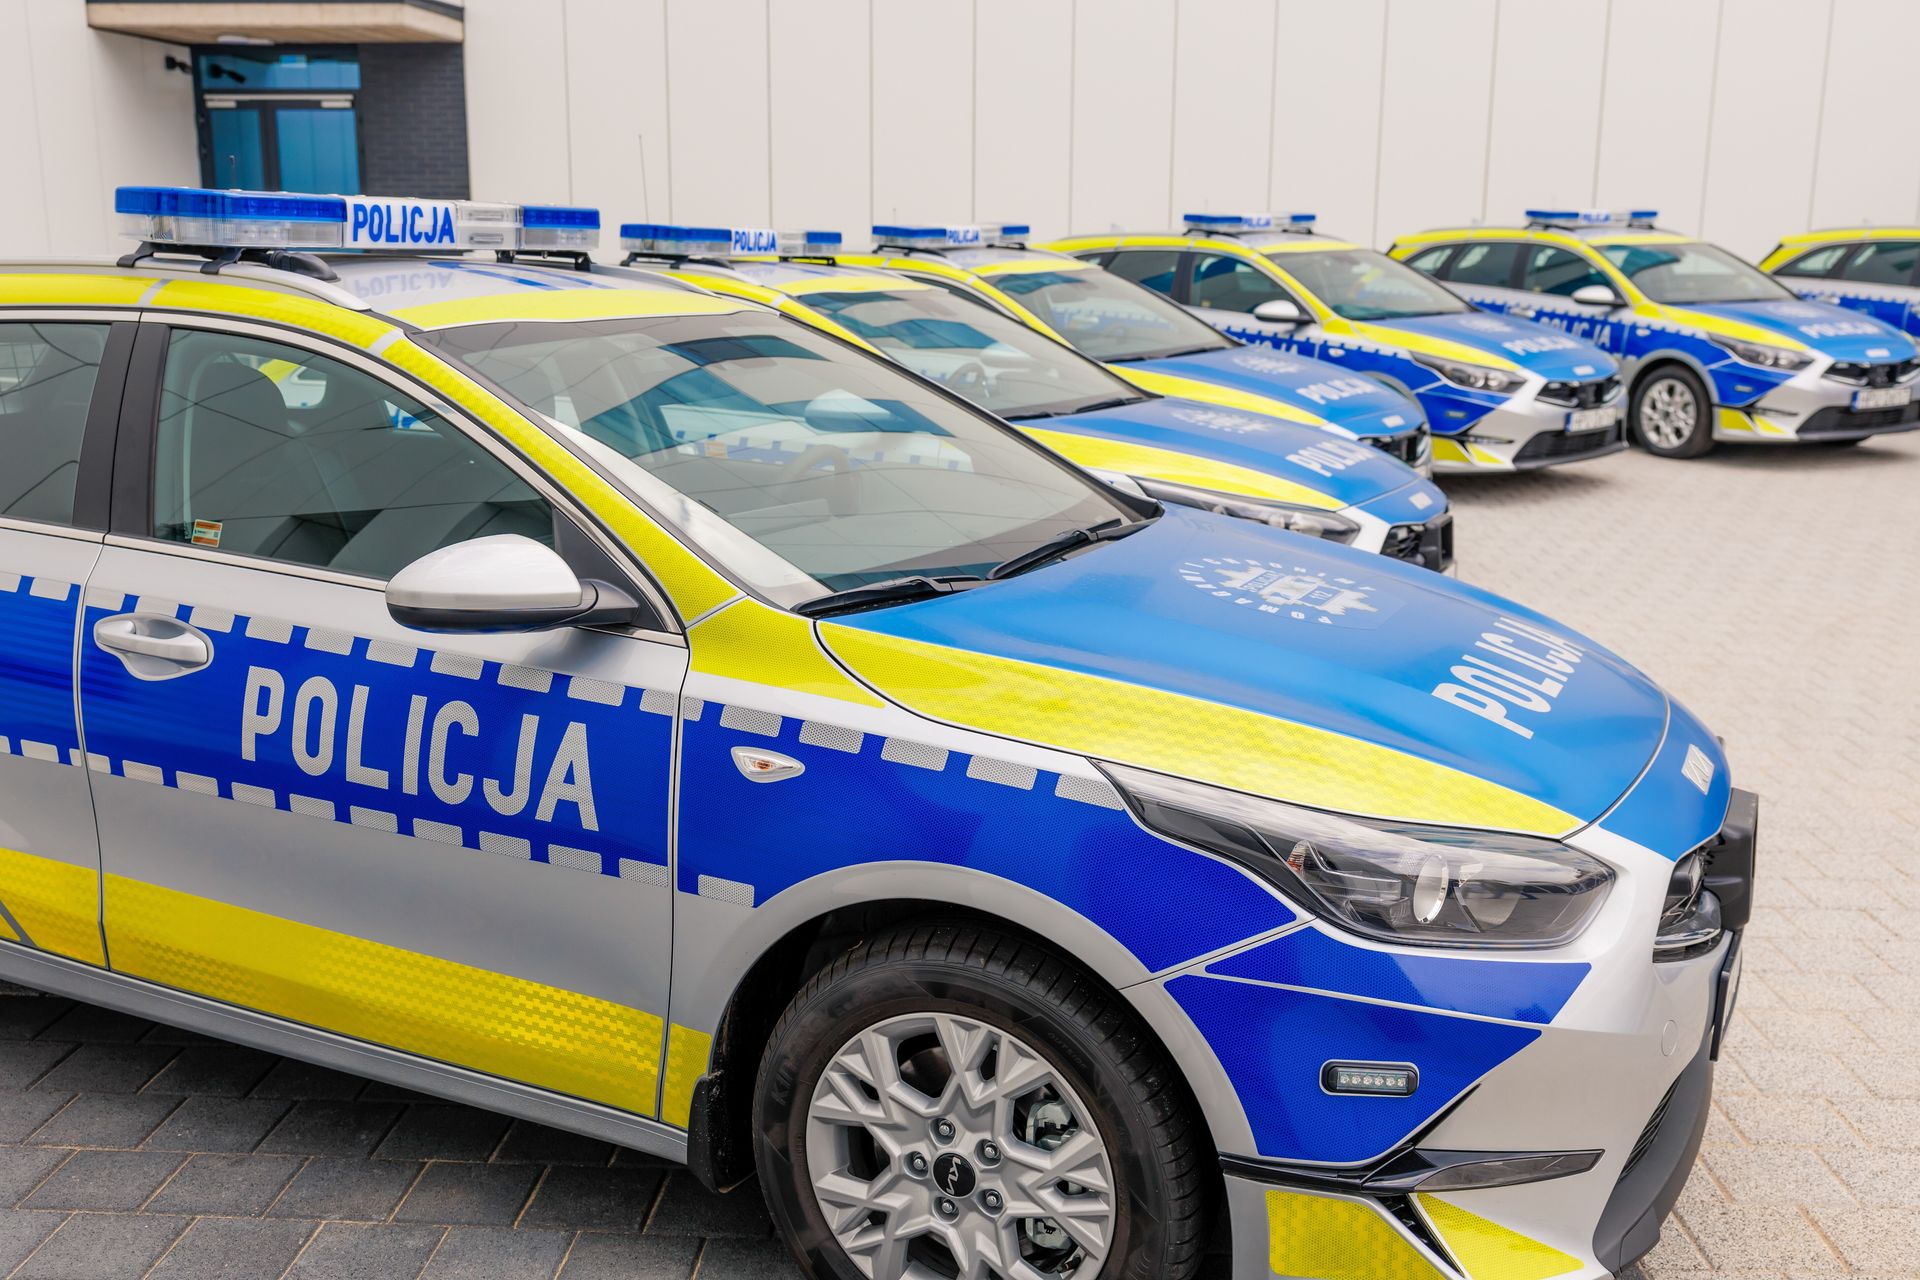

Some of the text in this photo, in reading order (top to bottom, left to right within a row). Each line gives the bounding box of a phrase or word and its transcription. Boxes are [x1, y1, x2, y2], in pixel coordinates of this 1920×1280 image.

[353, 204, 455, 243] POLICJA
[733, 231, 777, 251] POLICJA
[1431, 616, 1585, 739] POLICJA
[241, 665, 599, 832] POLICJA
